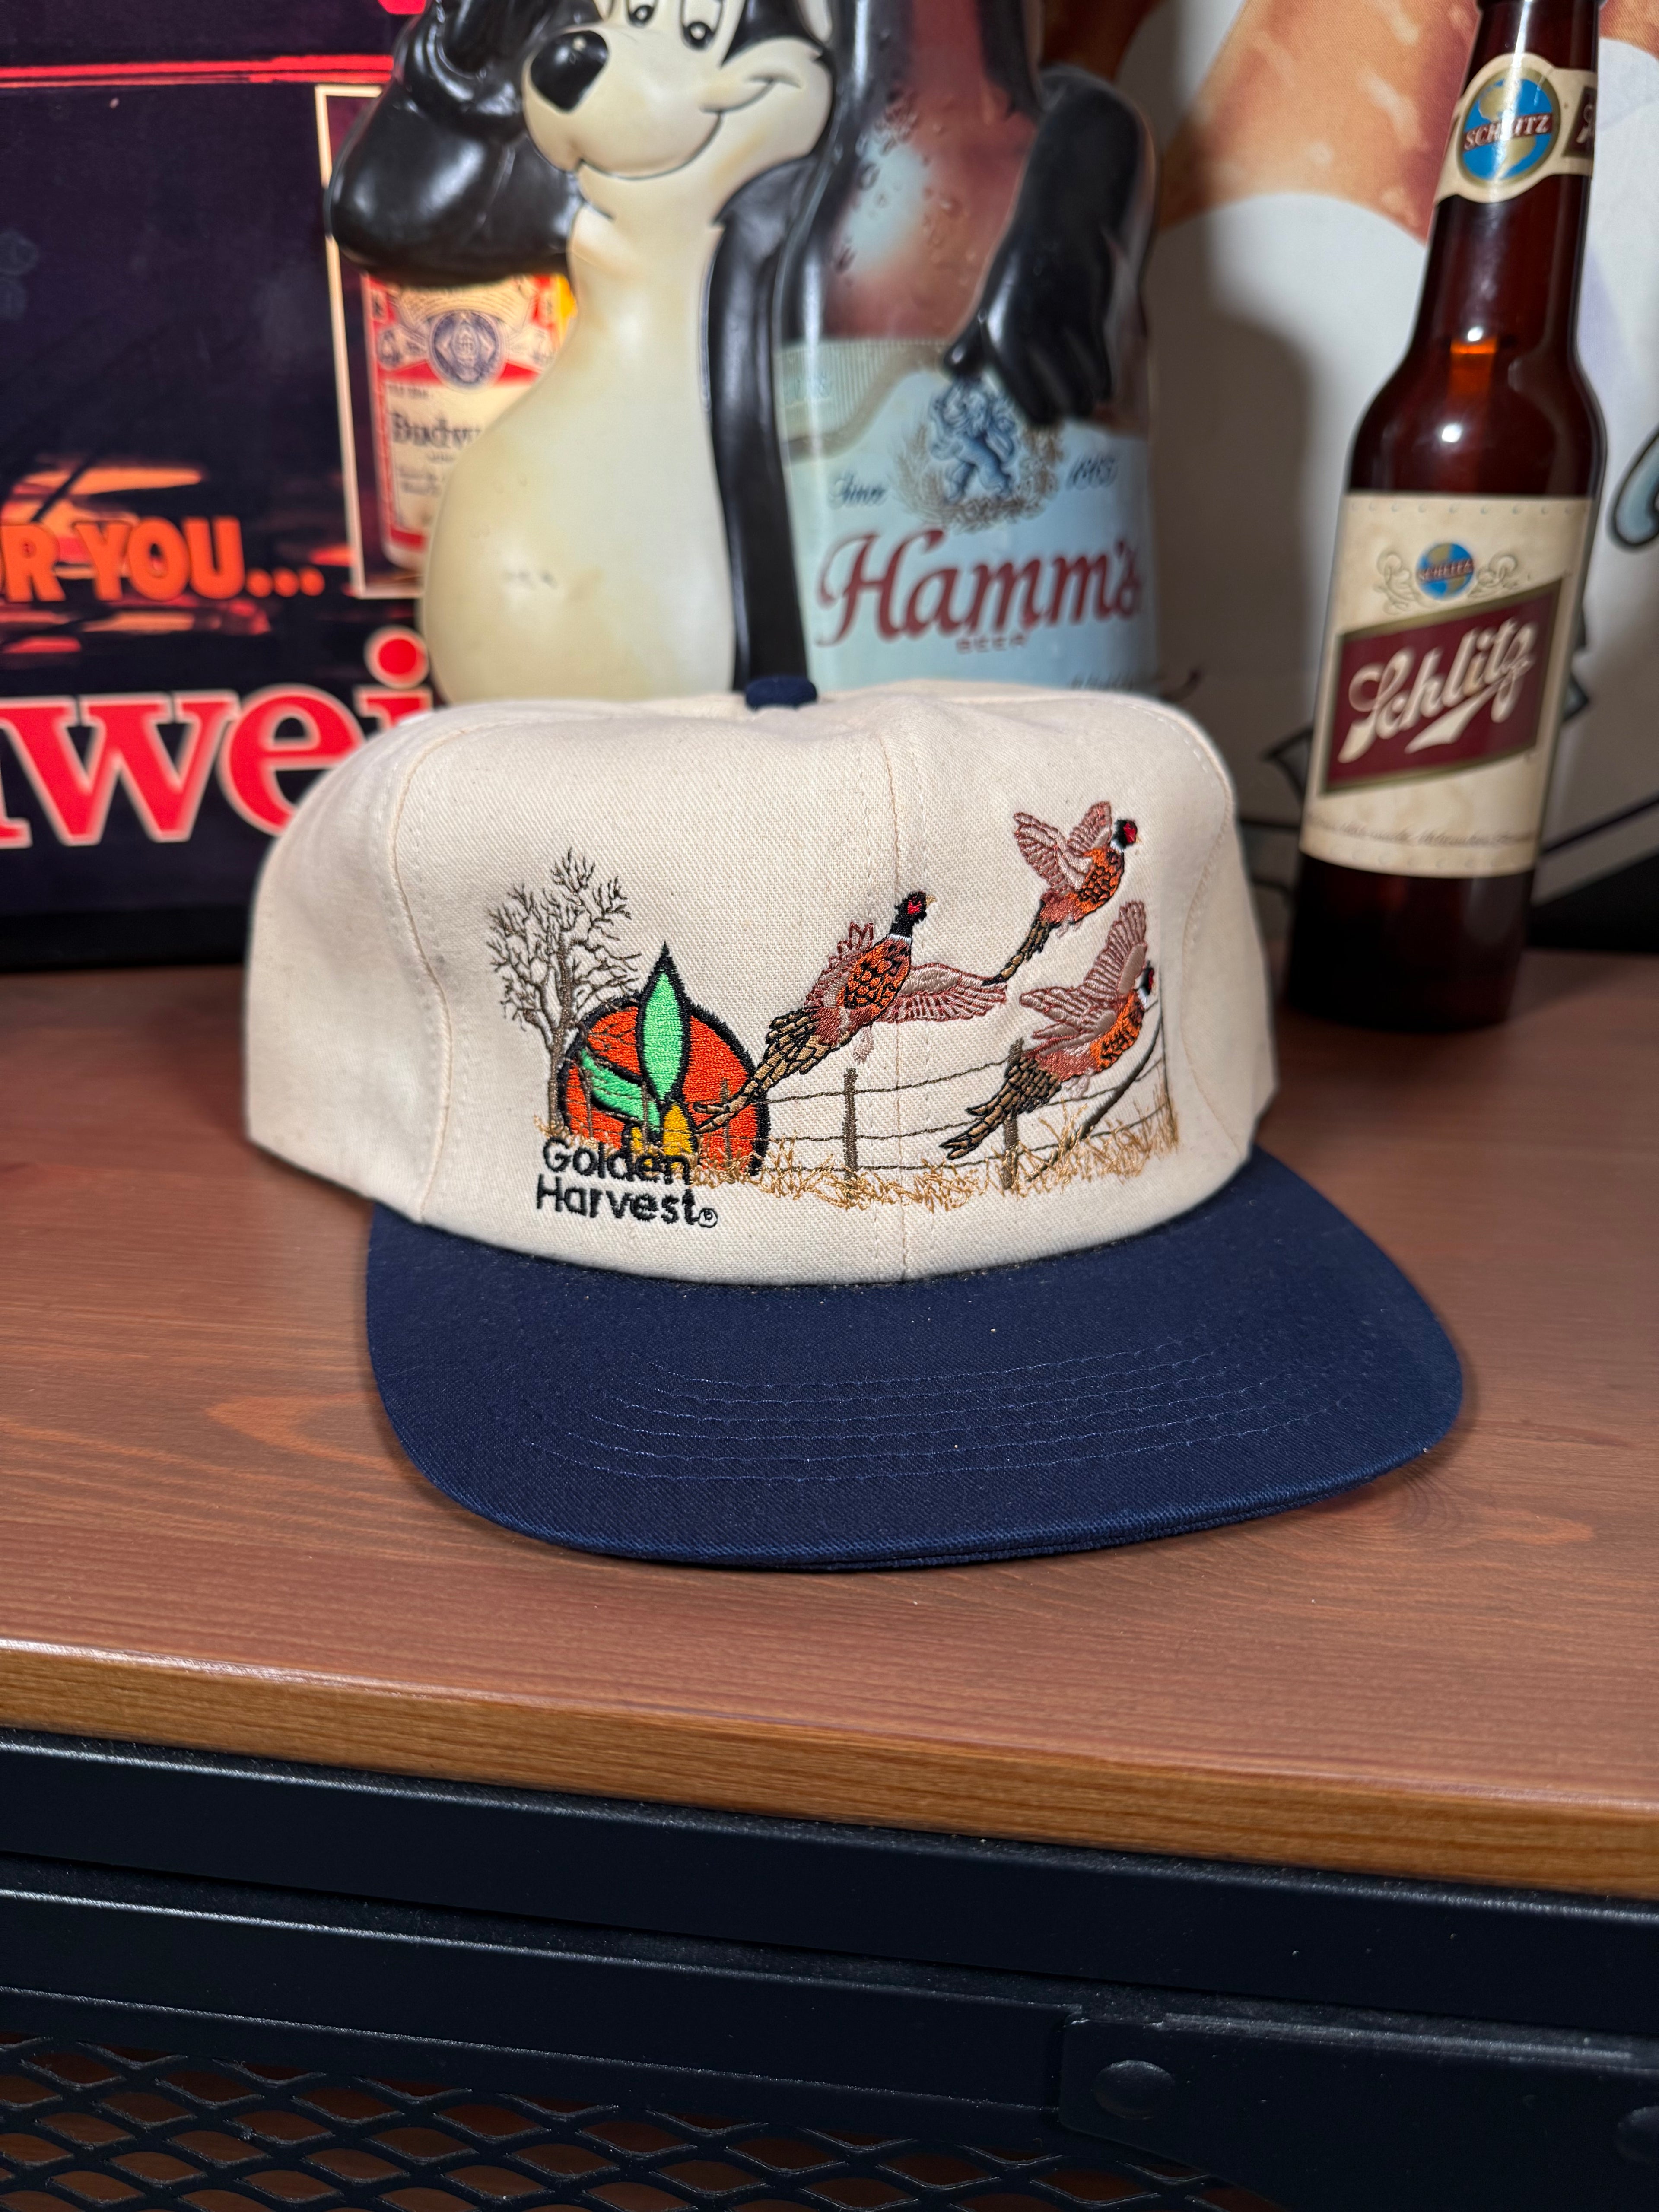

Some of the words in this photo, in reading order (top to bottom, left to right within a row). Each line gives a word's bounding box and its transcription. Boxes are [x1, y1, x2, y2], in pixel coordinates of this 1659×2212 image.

[1464, 114, 1551, 151] SCHITZ
[0, 524, 66, 602] R
[815, 528, 1143, 648] Hamm's
[956, 632, 1028, 655] BEER
[1338, 617, 1538, 764] Schlitz
[543, 1137, 692, 1185] Golden
